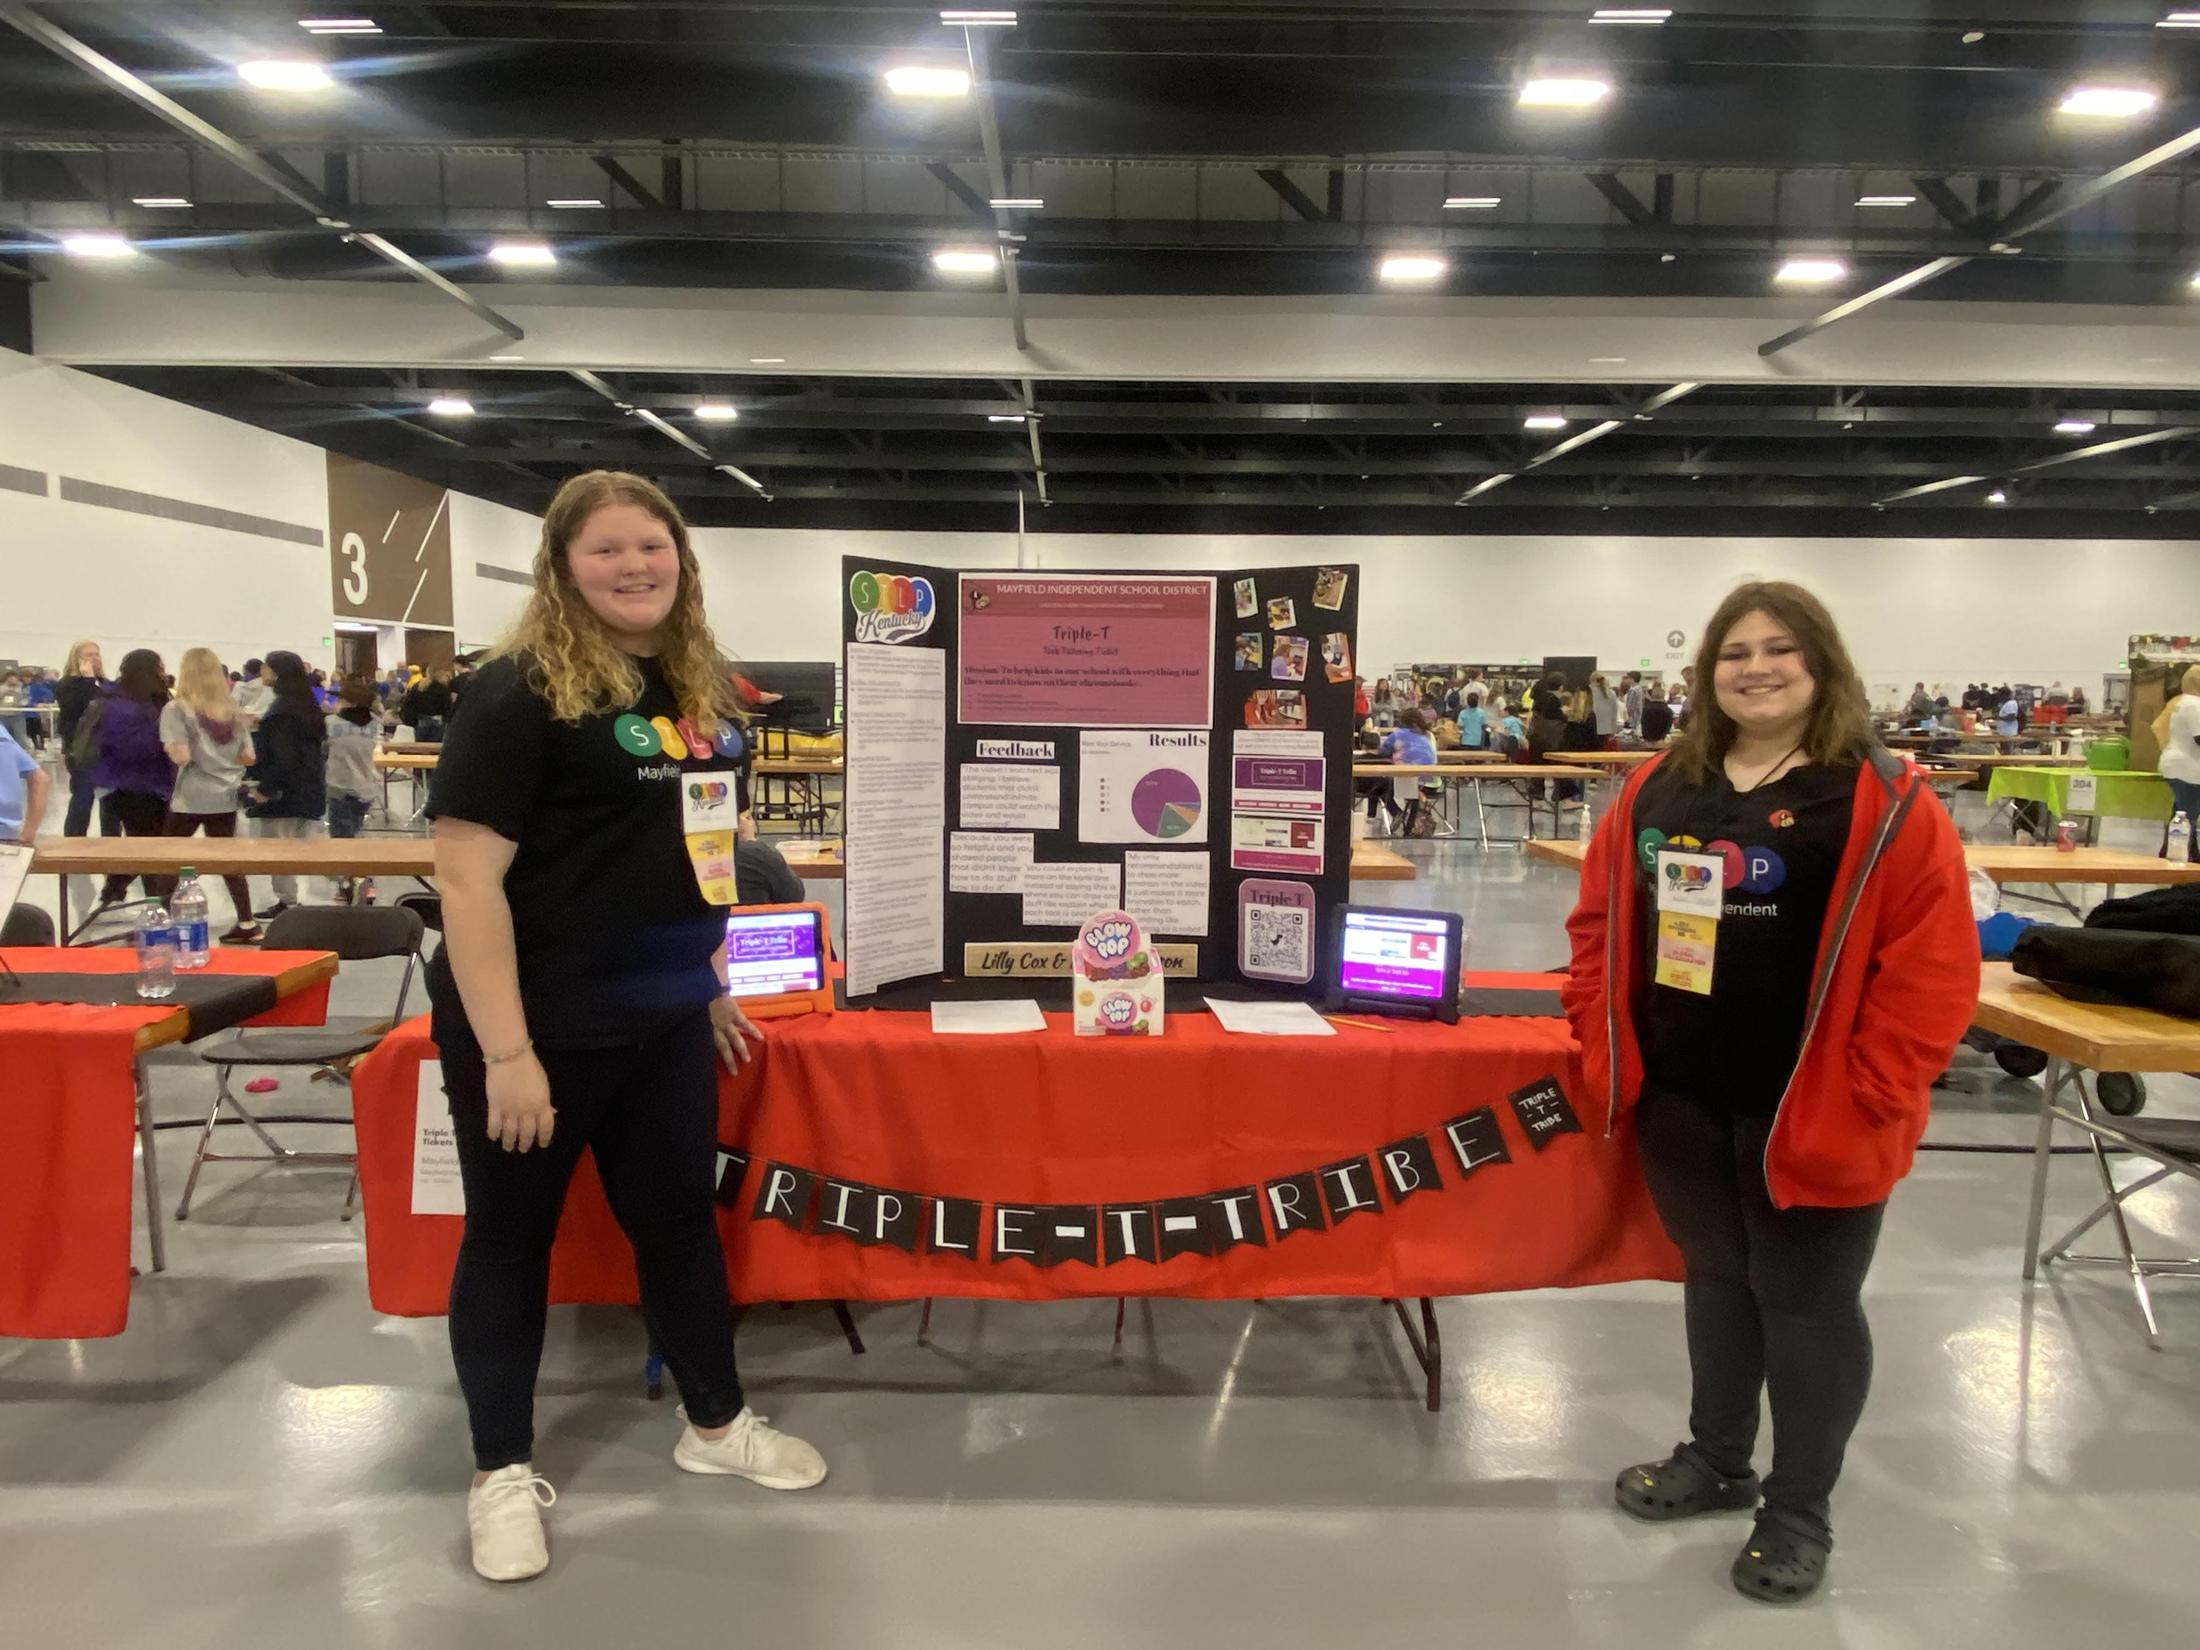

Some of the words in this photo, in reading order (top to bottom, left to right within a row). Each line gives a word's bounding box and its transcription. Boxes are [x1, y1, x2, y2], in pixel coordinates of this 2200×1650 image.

[341, 532, 369, 605] 3
[996, 584, 1046, 594] MAYFIELD
[1047, 585, 1118, 595] INDEPENDENT
[1119, 585, 1161, 595] SCHOOL
[1163, 585, 1208, 595] DISTRICT
[858, 608, 925, 640] Kentucky
[1052, 625, 1111, 642] Triple-T
[1084, 667, 1110, 676] school
[1132, 667, 1180, 679] everything
[1150, 733, 1207, 747] Results
[979, 742, 1053, 758] Feedback
[1250, 889, 1292, 908] Triple
[1294, 892, 1305, 905] T
[1085, 920, 1131, 947] BLOW
[1097, 936, 1131, 958] POP
[982, 951, 1015, 975] Lilly
[1020, 952, 1047, 969] Cox
[1052, 953, 1066, 969] &
[1101, 999, 1133, 1016] BLOW
[1109, 1010, 1131, 1024] POP
[1518, 1088, 1557, 1110] TRIPLE
[1531, 1113, 1562, 1131] TRIBE
[423, 1128, 449, 1140] Triple
[423, 1138, 454, 1147] Tickets
